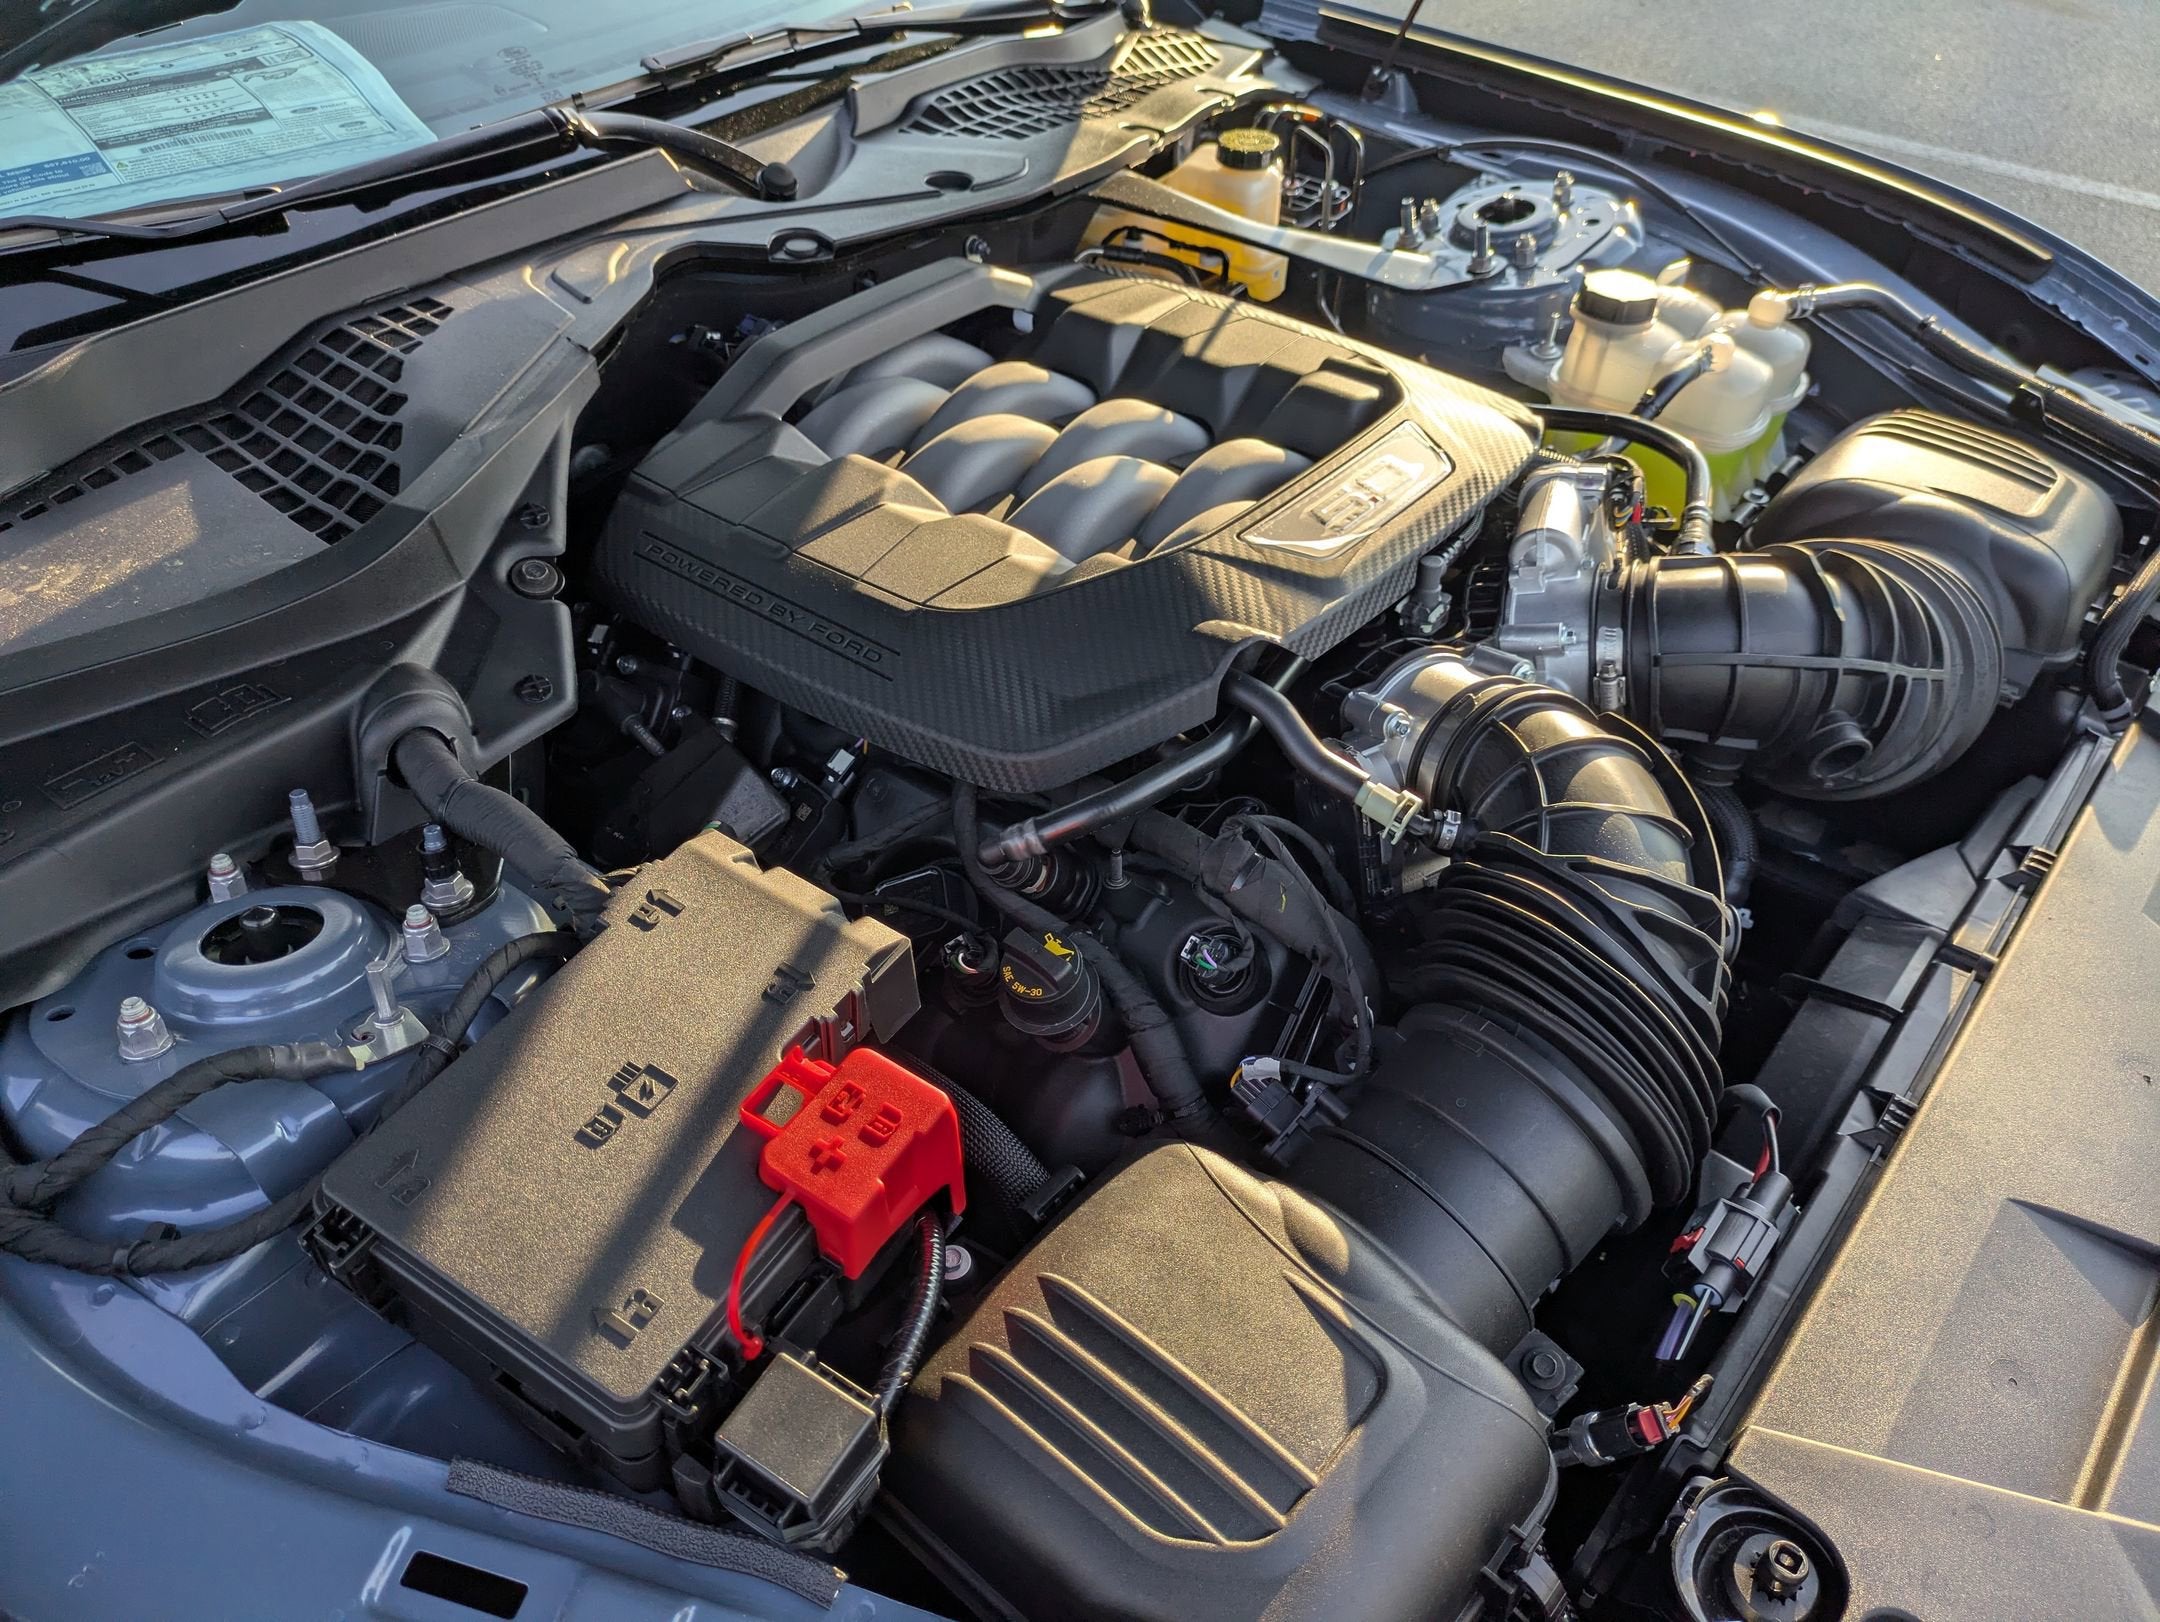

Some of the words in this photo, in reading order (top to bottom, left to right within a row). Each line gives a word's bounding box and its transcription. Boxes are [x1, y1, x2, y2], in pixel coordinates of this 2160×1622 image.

[645, 544, 764, 605] POWERED
[766, 601, 806, 623] BY
[808, 619, 884, 664] FORD
[1002, 966, 1015, 983] SAE
[1011, 981, 1043, 997] 5W-30
